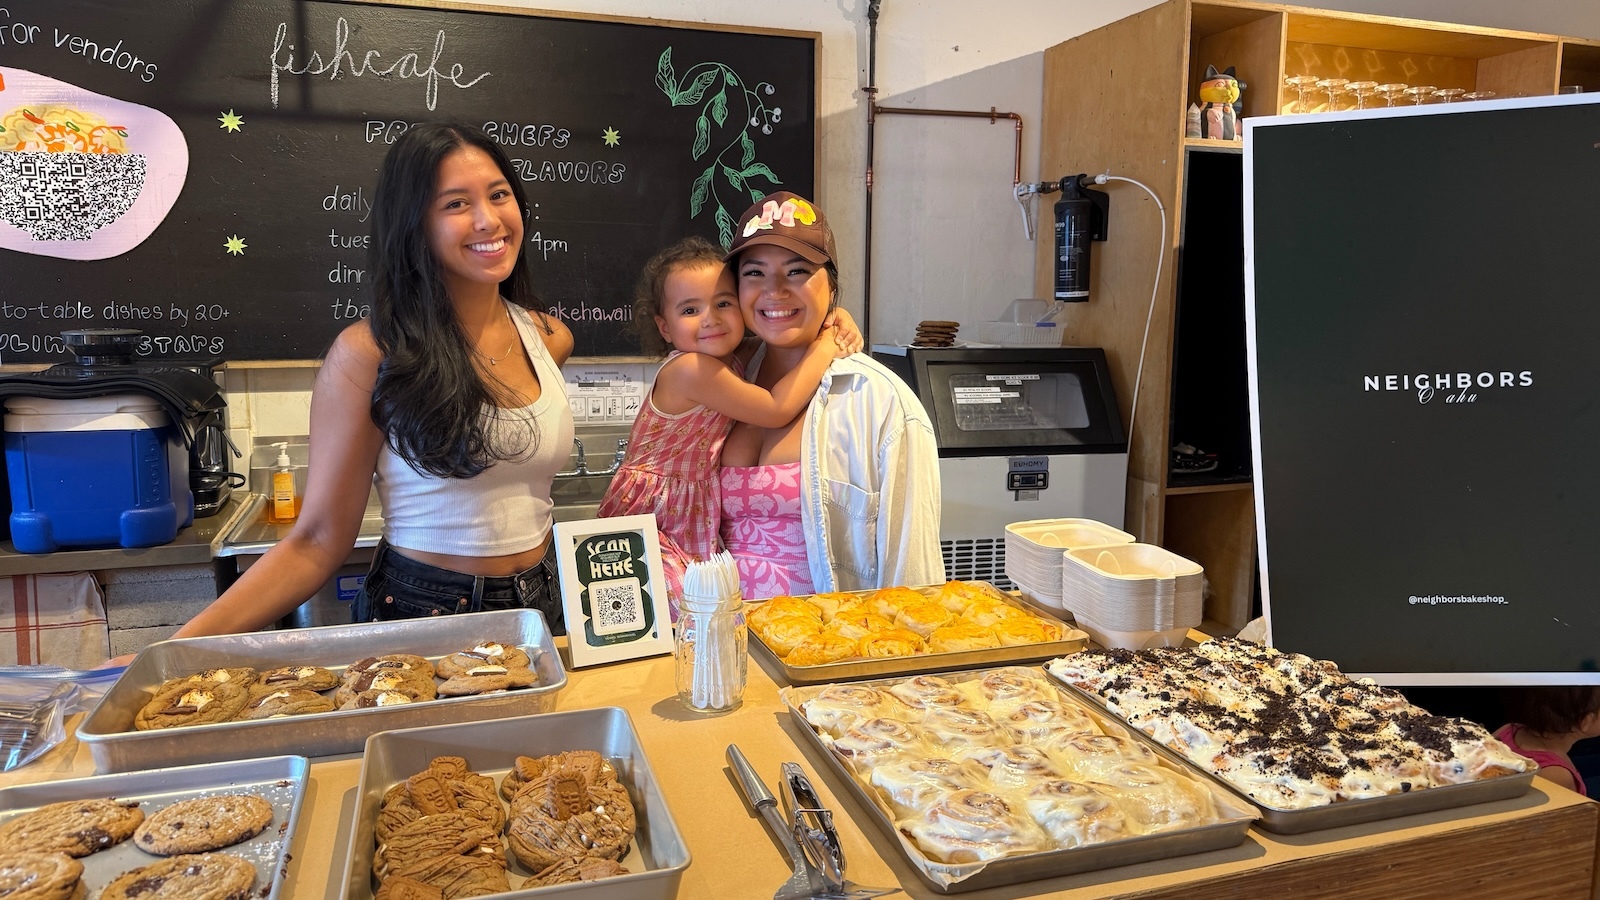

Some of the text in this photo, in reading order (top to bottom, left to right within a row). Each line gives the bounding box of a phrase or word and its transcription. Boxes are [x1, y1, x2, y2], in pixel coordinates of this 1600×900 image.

[54, 28, 158, 83] vendors
[270, 17, 492, 111] fishcafe
[322, 185, 373, 223] daily
[531, 231, 568, 261] 4pm
[103, 300, 163, 320] dishes
[170, 303, 189, 327] by
[195, 304, 230, 321] 20+
[548, 301, 632, 322] akehawaii
[135, 335, 225, 356] STARS
[1364, 371, 1533, 391] NEIGHBORS
[586, 538, 631, 557] SCAN
[589, 555, 634, 578] HERE
[1408, 594, 1509, 606] @neighborsbakeshop_
